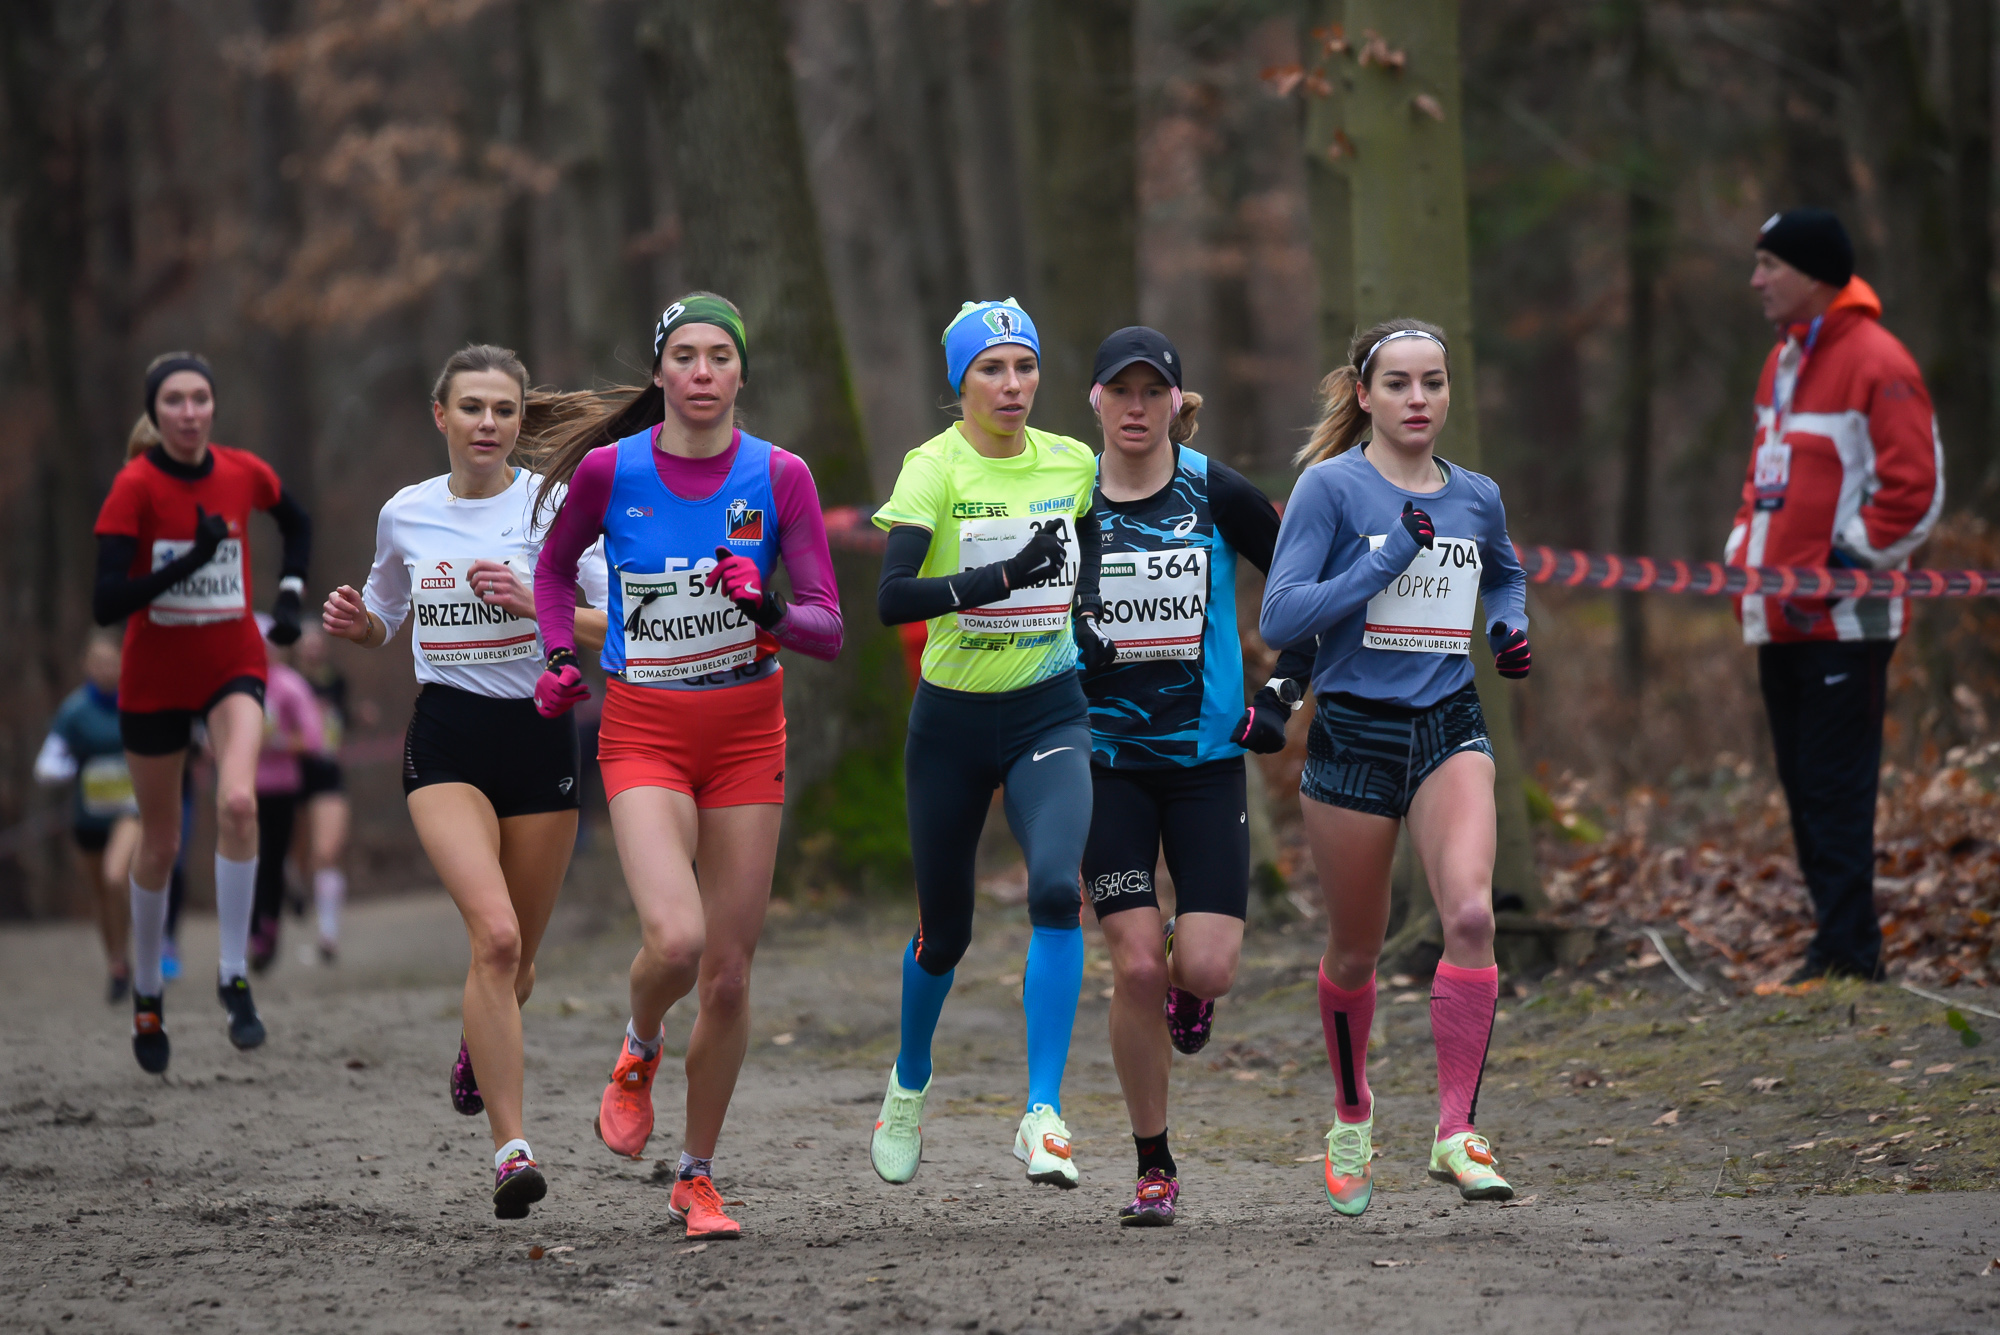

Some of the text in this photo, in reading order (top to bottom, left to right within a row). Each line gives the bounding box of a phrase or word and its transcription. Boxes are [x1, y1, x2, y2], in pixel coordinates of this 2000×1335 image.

[1029, 496, 1075, 512] SONAROL
[626, 506, 653, 517] esa
[1437, 542, 1477, 569] 704
[1147, 553, 1201, 580] 564
[422, 578, 454, 588] ORLEN
[964, 618, 1019, 629] TOMASZÓW
[1022, 617, 1061, 627] LUBELSKI
[1370, 636, 1423, 647] TOMASZÓW
[1424, 640, 1461, 649] LUBELSKI
[473, 651, 511, 660] LUBELSKI
[513, 645, 532, 656] 2021
[1145, 649, 1185, 658] LUBELSKI
[633, 667, 690, 679] TOMASZÓW
[691, 657, 730, 673] LUBELSKI
[732, 650, 752, 663] 2021
